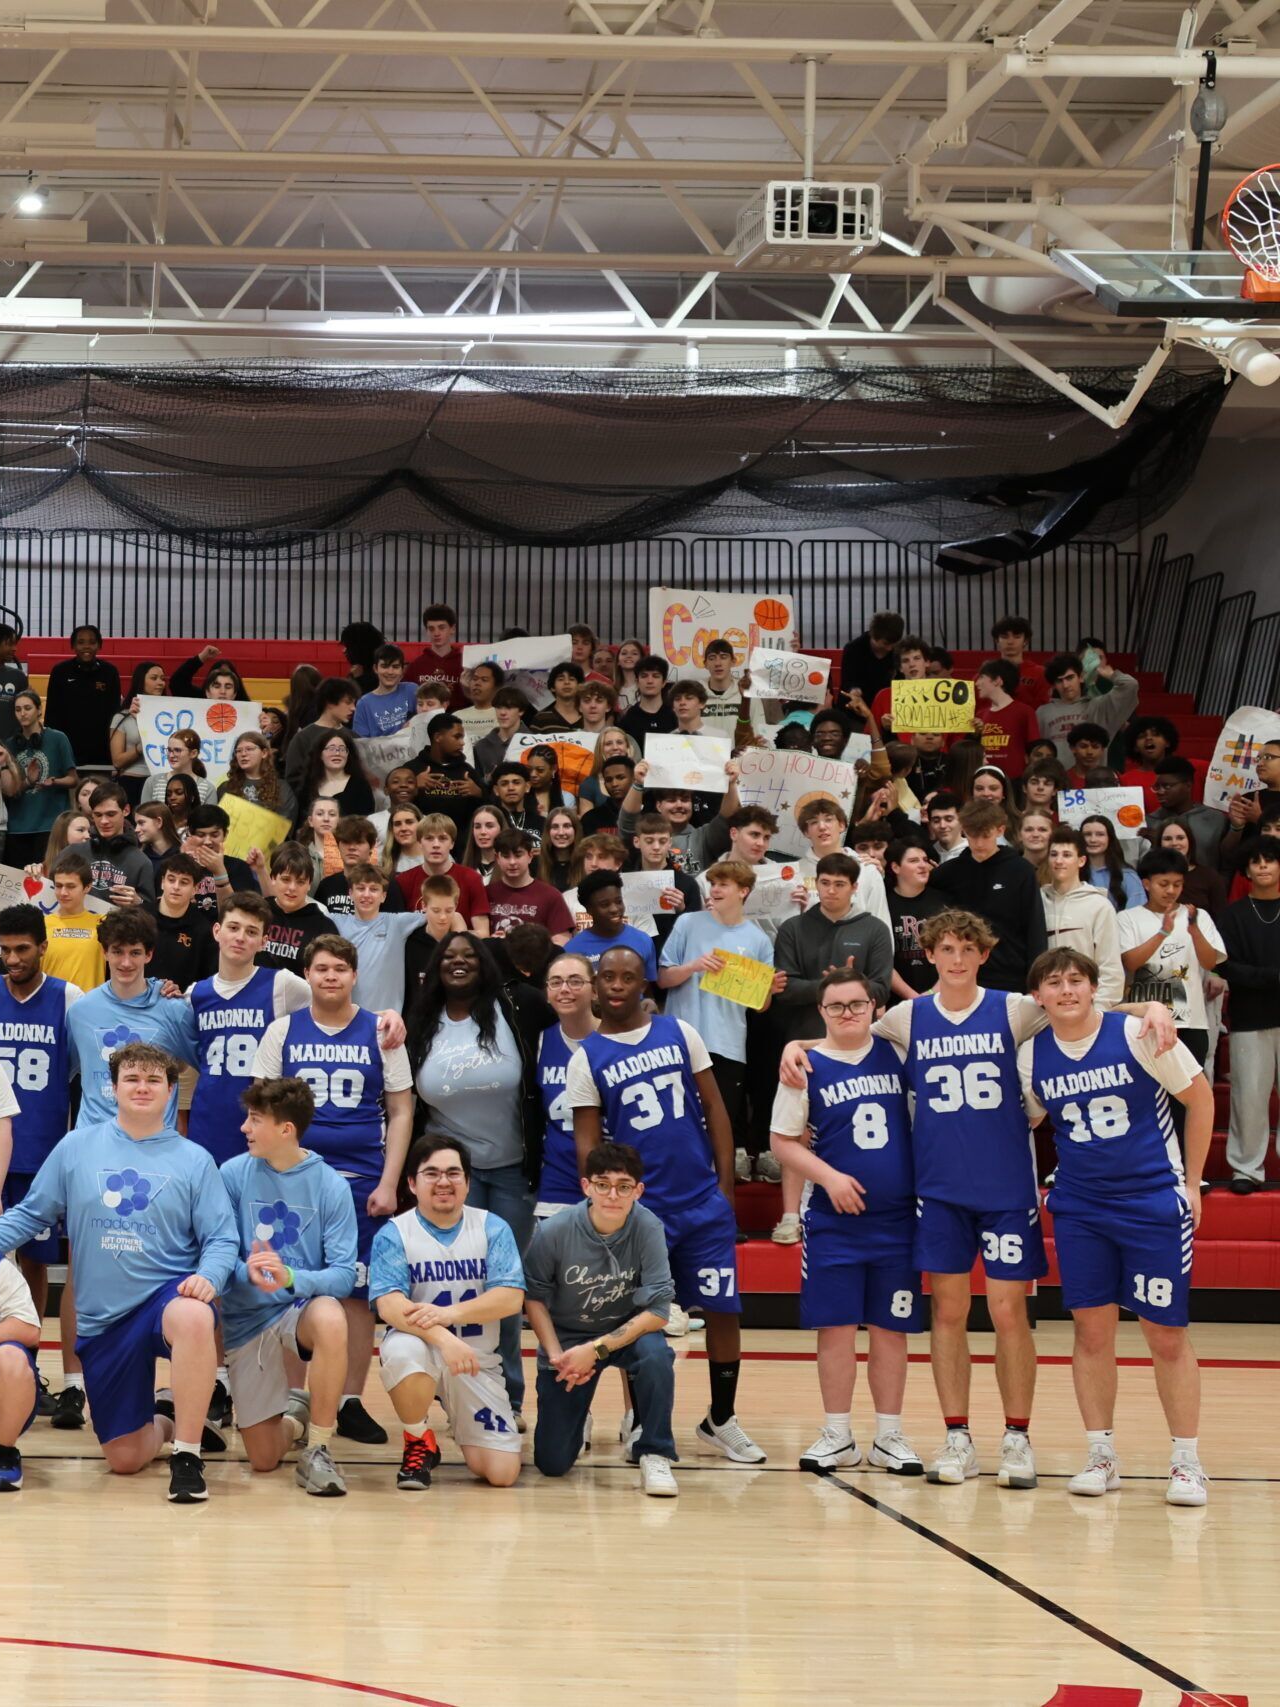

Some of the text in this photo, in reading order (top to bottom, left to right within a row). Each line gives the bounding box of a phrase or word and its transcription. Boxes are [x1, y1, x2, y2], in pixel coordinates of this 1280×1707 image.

[419, 675, 461, 684] RONCALLI
[764, 658, 808, 692] 18
[933, 679, 970, 705] GO
[154, 709, 194, 737] GO
[895, 703, 948, 728] ROMAIN
[520, 734, 583, 748] Chelsea
[740, 753, 776, 776] GO
[784, 754, 857, 787] HOLDEN
[1063, 789, 1087, 807] 58
[198, 1008, 265, 1031] MADONNA
[206, 1033, 258, 1077] 48
[289, 1044, 372, 1065] MADONNA
[916, 1033, 1005, 1061] MADONNA
[602, 1045, 684, 1088] MADONNA
[820, 1074, 903, 1108] MADONNA
[924, 1061, 1004, 1113] 36
[1041, 1063, 1134, 1102] MADONNA
[621, 1072, 686, 1132] 37
[851, 1103, 889, 1150] 8
[1061, 1094, 1133, 1143] 18
[91, 1216, 158, 1235] madonna
[101, 1236, 144, 1247] LIFT OTHERS
[101, 1243, 144, 1253] PUSH LIMITS
[981, 1231, 1024, 1265] 36
[407, 1257, 489, 1285] MADONNA
[697, 1268, 735, 1297] 37
[890, 1289, 914, 1319] 8
[1133, 1273, 1174, 1308] 18
